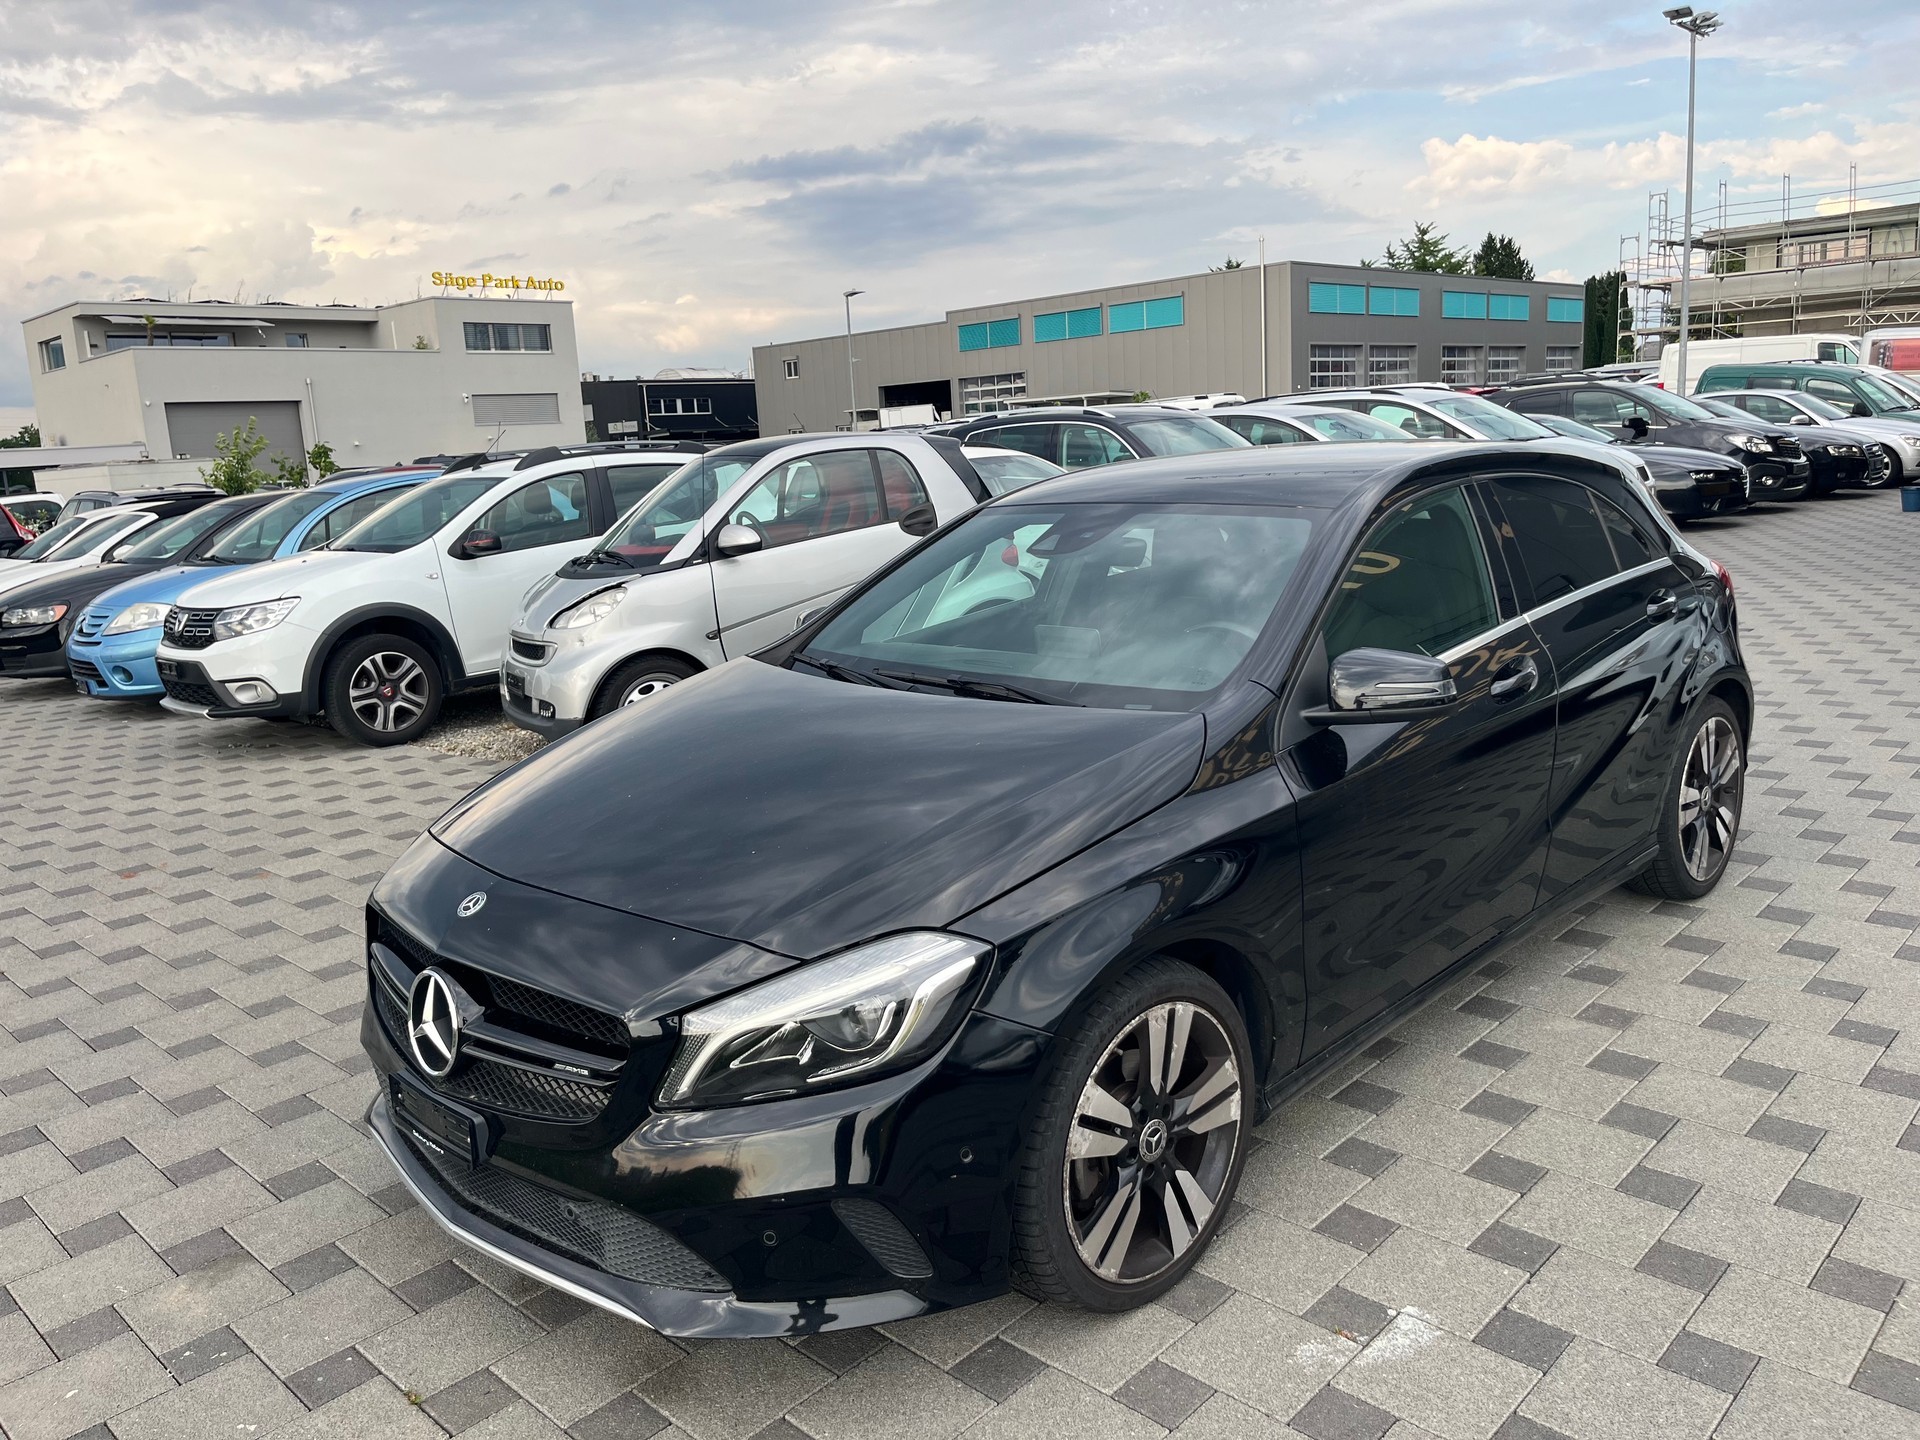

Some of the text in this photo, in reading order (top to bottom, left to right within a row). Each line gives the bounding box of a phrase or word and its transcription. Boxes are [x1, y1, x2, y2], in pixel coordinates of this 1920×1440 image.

[431, 271, 565, 291] Säge Park Auto
